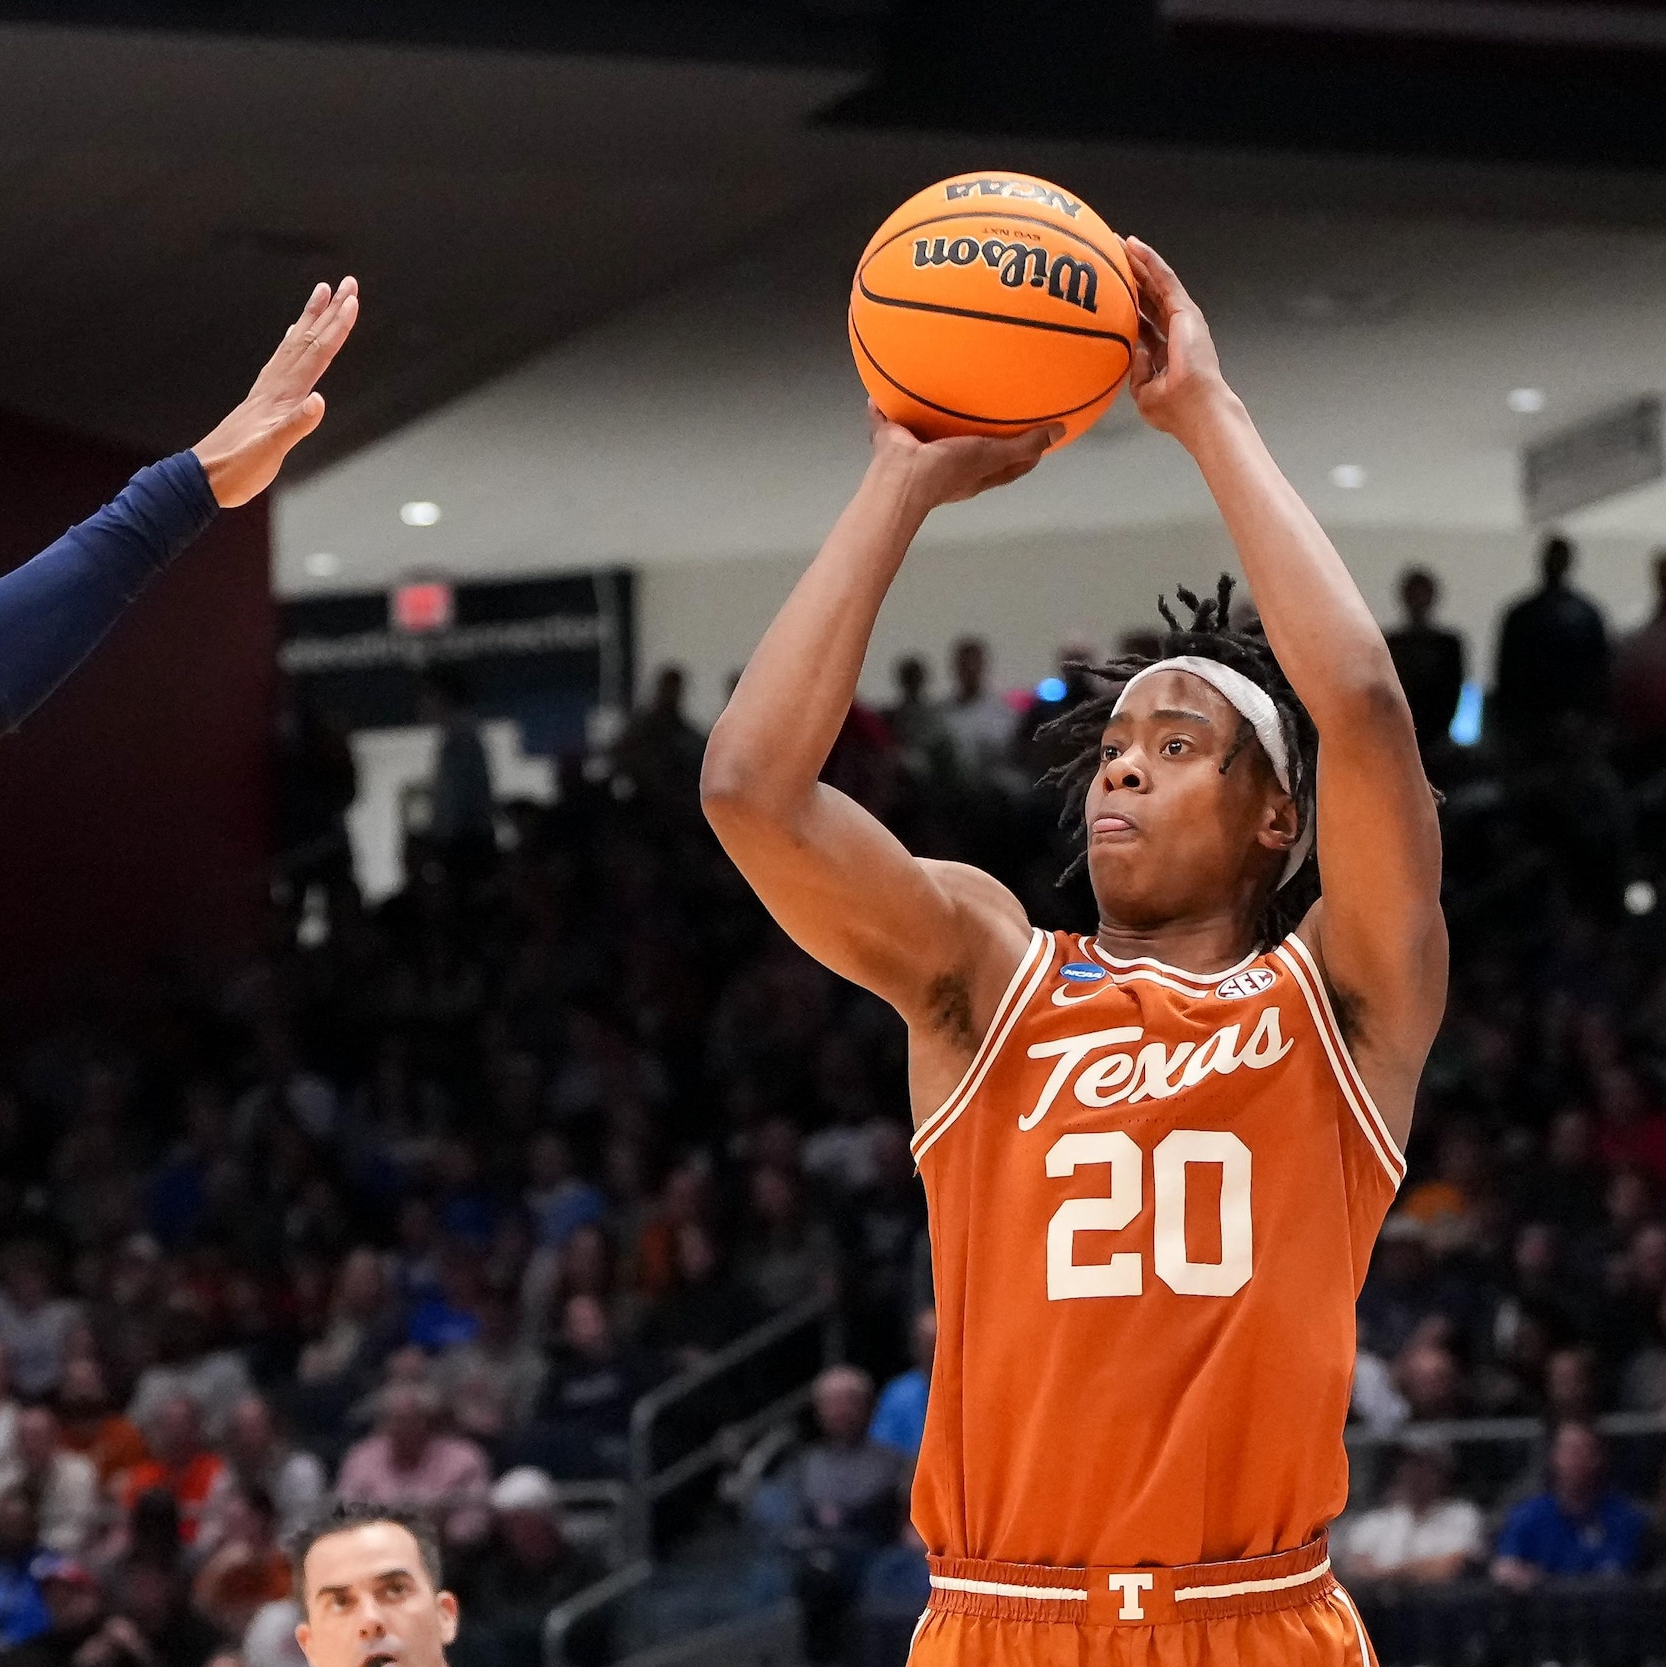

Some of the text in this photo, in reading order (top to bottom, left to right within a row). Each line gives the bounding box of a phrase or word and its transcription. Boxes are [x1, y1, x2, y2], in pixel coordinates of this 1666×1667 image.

[944, 178, 1082, 218] NCAA
[912, 237, 1098, 314] Wilson
[1062, 967, 1103, 980] NCAA
[1218, 970, 1274, 998] SEC
[1017, 1006, 1295, 1133] Texas
[1044, 1128, 1253, 1302] 20
[1108, 1572, 1154, 1620] T
